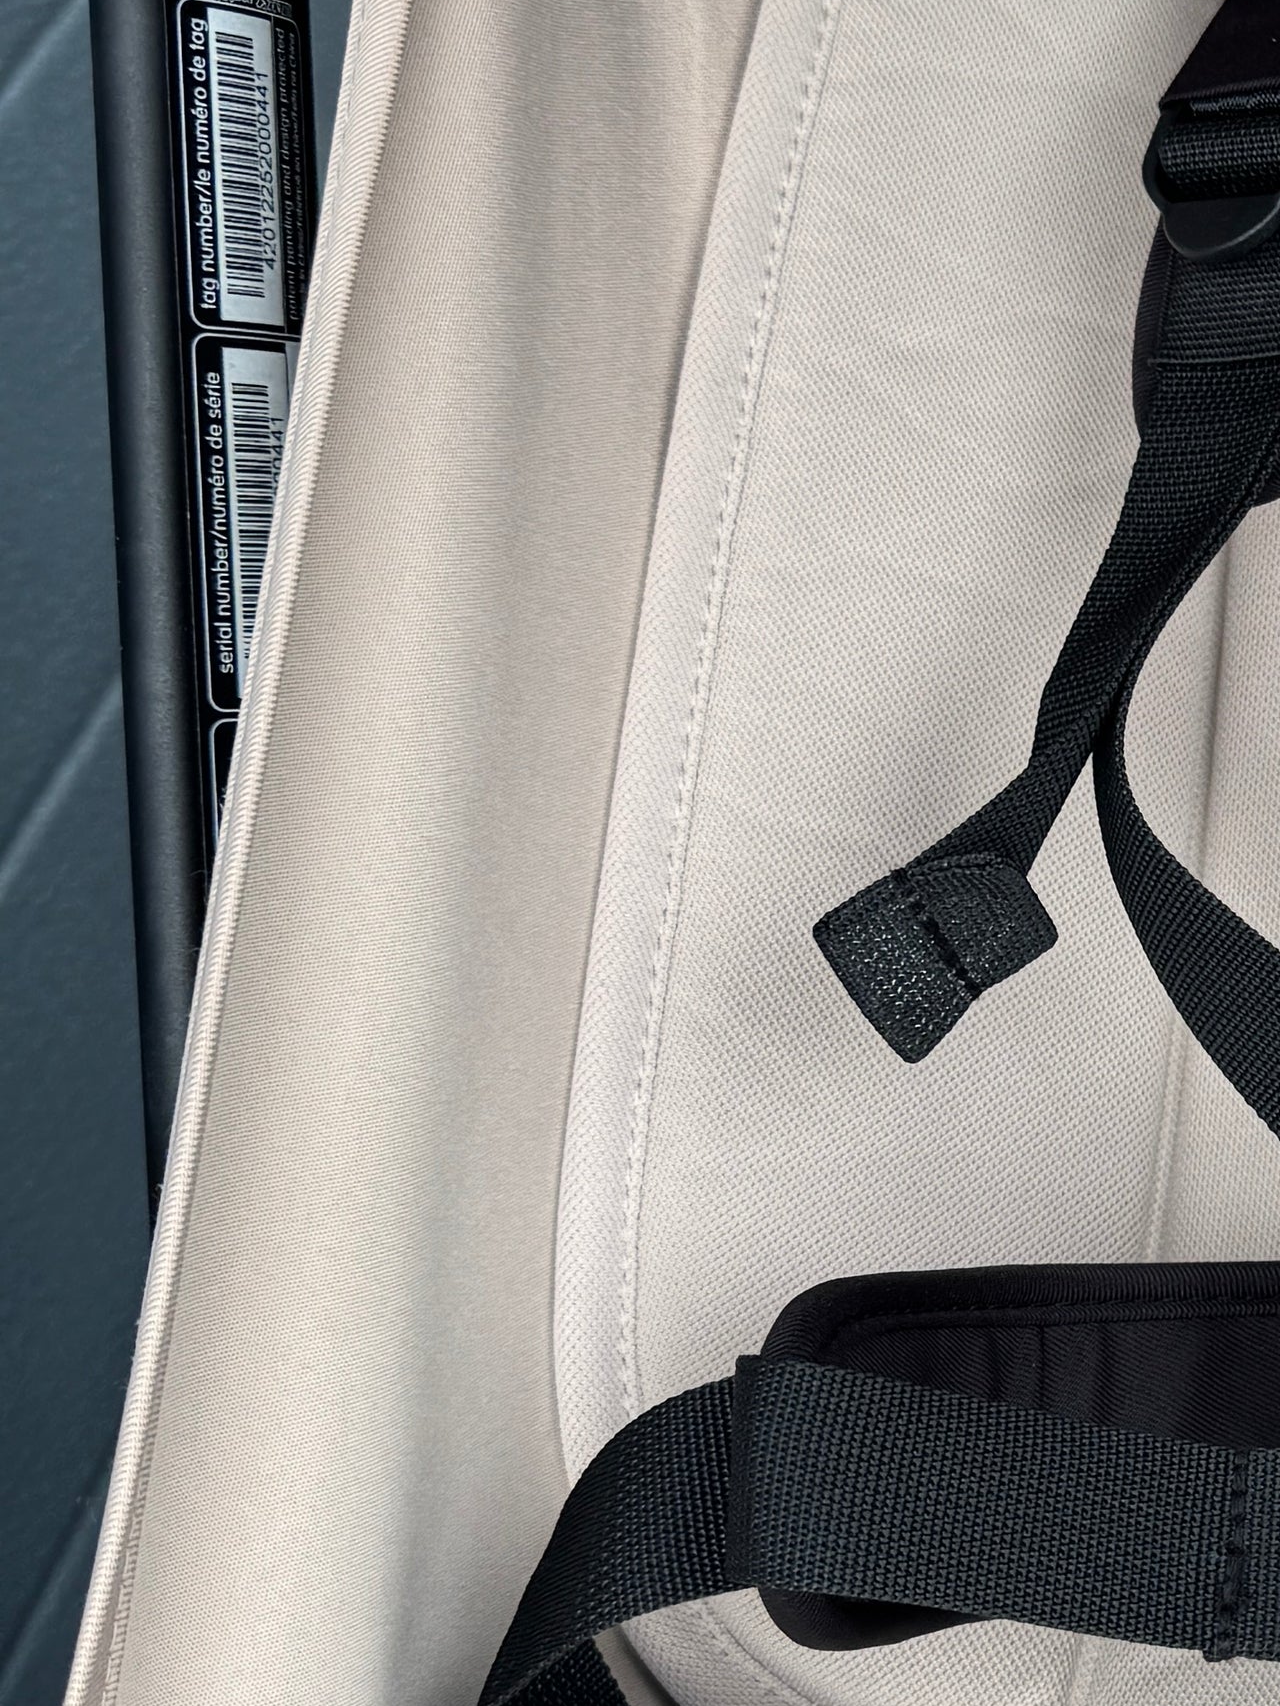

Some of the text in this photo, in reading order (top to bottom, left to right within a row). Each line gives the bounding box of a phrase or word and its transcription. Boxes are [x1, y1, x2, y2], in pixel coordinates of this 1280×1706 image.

[275, 27, 289, 104] protected
[188, 17, 221, 310] tag number/le numéro de tag
[281, 164, 292, 196] and
[203, 371, 234, 674] serial number/numéro de série
